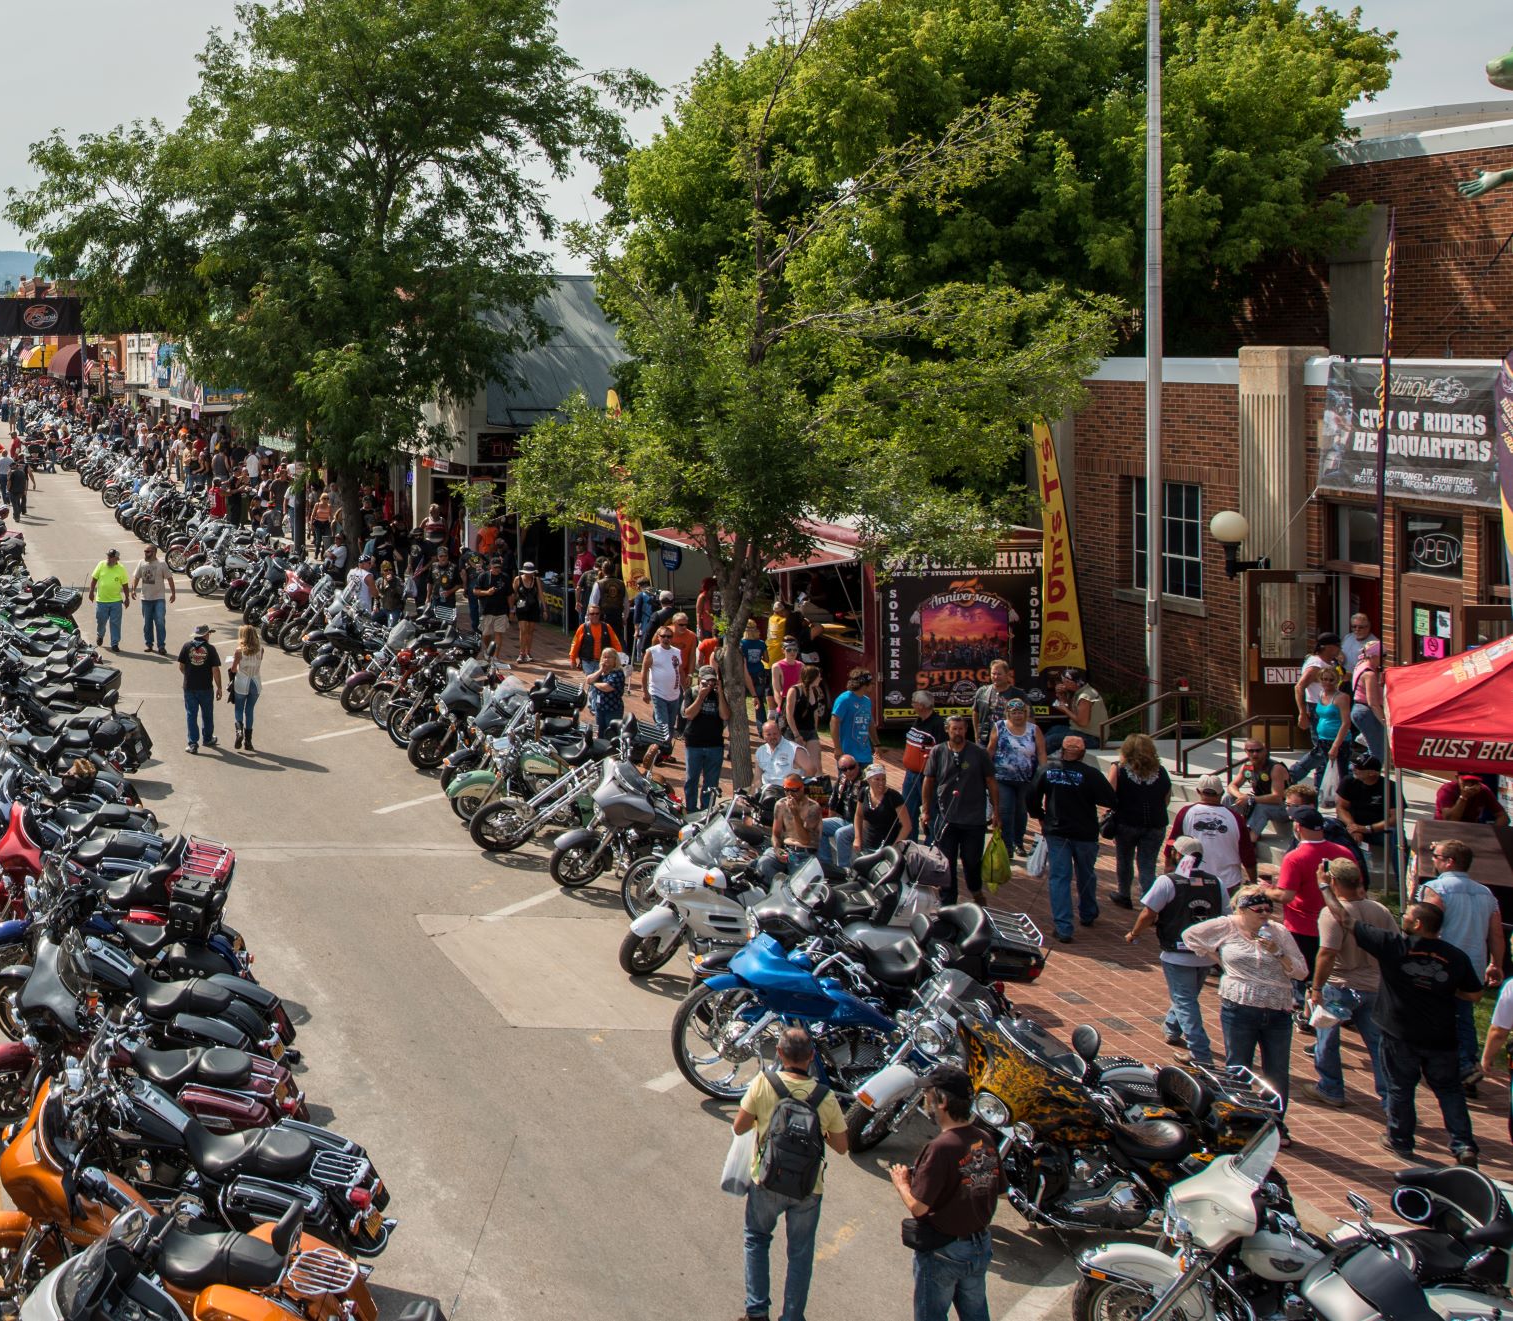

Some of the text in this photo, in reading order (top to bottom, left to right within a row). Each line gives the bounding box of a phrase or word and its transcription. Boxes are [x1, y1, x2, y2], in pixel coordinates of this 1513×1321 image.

[1397, 411, 1420, 430] OF
[1423, 412, 1487, 436] RIDERS
[1353, 431, 1491, 462] HEDQUARTERS
[1354, 474, 1394, 486] RESTRMS
[1402, 479, 1451, 491] INFORMATION
[1453, 484, 1478, 495] INSIDE
[1360, 467, 1374, 476] AIR
[1375, 469, 1423, 480] NDITIONED
[1432, 475, 1474, 486] EXHIBITORS
[1413, 536, 1462, 565] OPEN
[928, 591, 1002, 609] Anniversary
[889, 589, 900, 680] SOLD HERE
[1029, 586, 1040, 677] SOLD HERE
[916, 668, 1016, 689] STURGS
[1266, 668, 1302, 683] ENTE
[1418, 737, 1475, 759] RUSS
